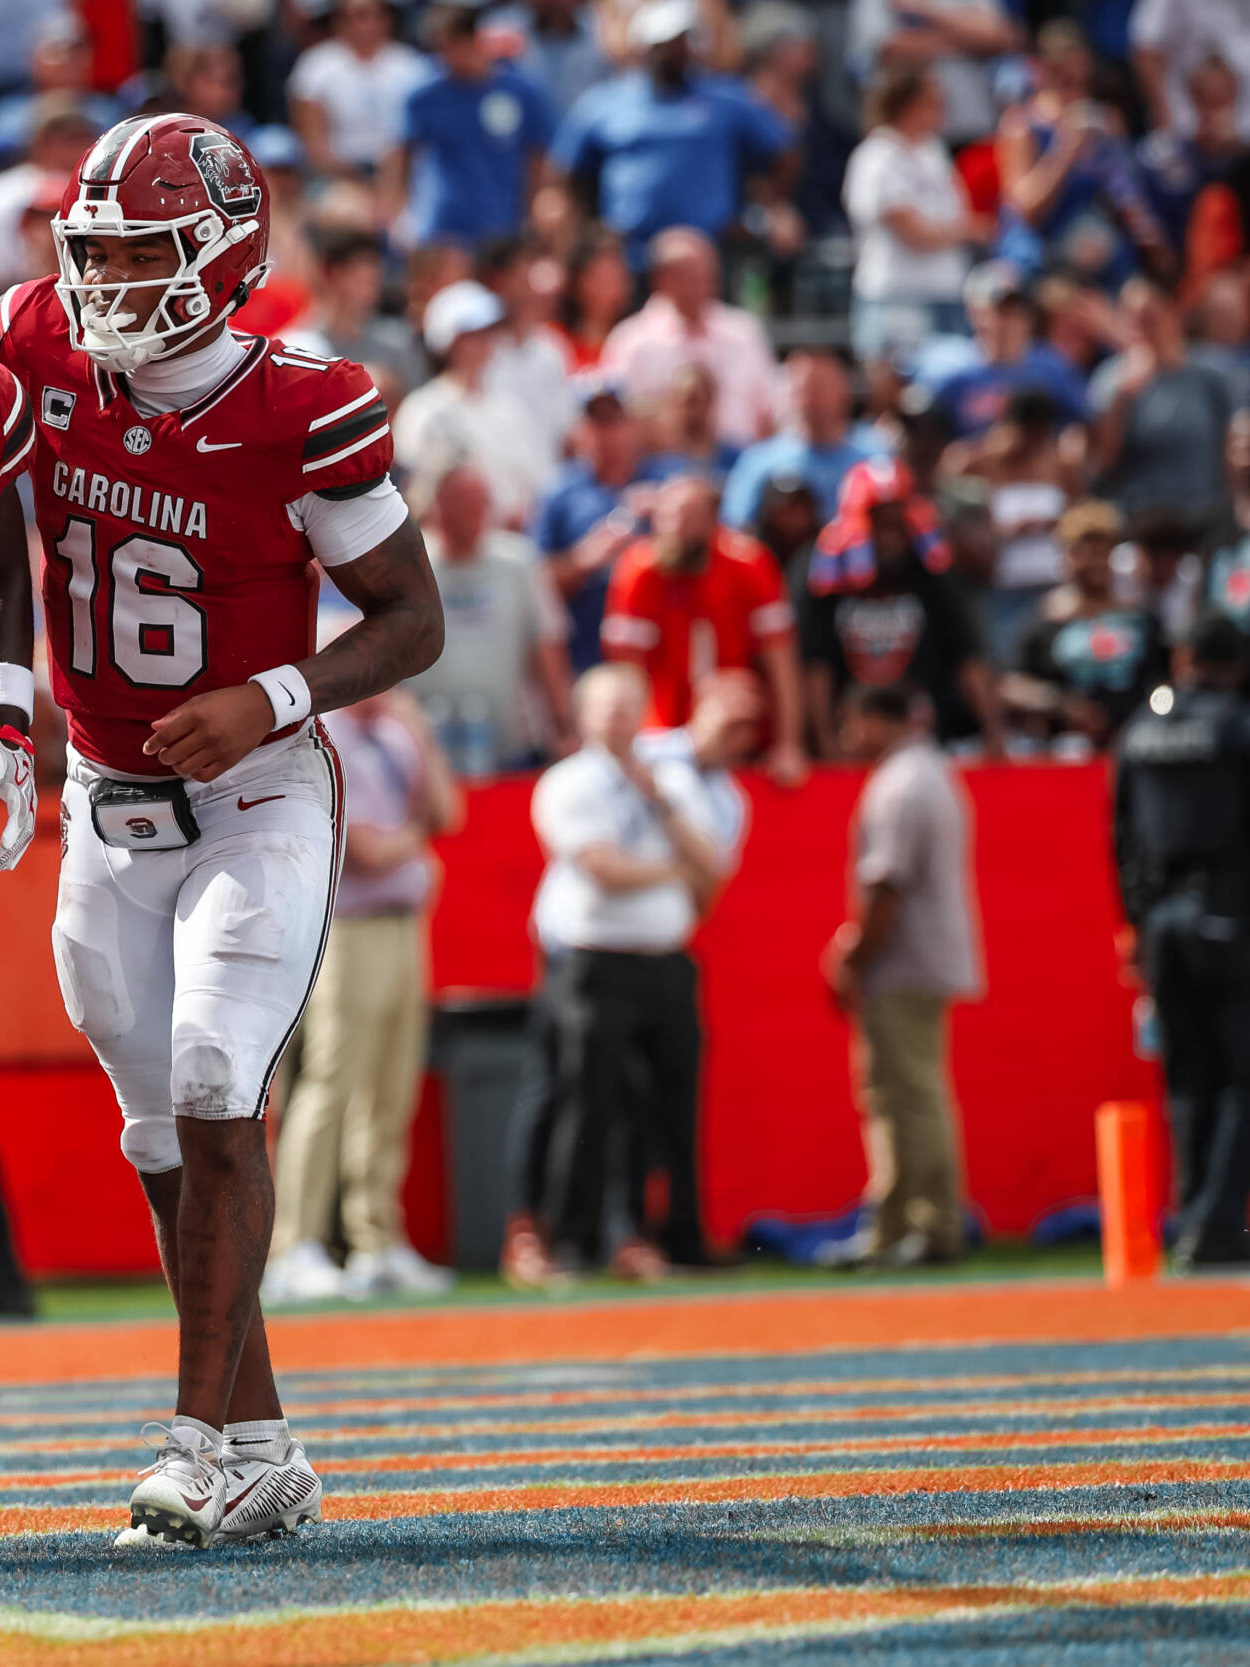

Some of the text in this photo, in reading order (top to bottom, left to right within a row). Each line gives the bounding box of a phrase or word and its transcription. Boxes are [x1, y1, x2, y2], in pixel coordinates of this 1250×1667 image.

[43, 387, 74, 427] C
[123, 426, 151, 455] SEC
[53, 460, 207, 540] CAROLINA
[54, 513, 208, 690] 16
